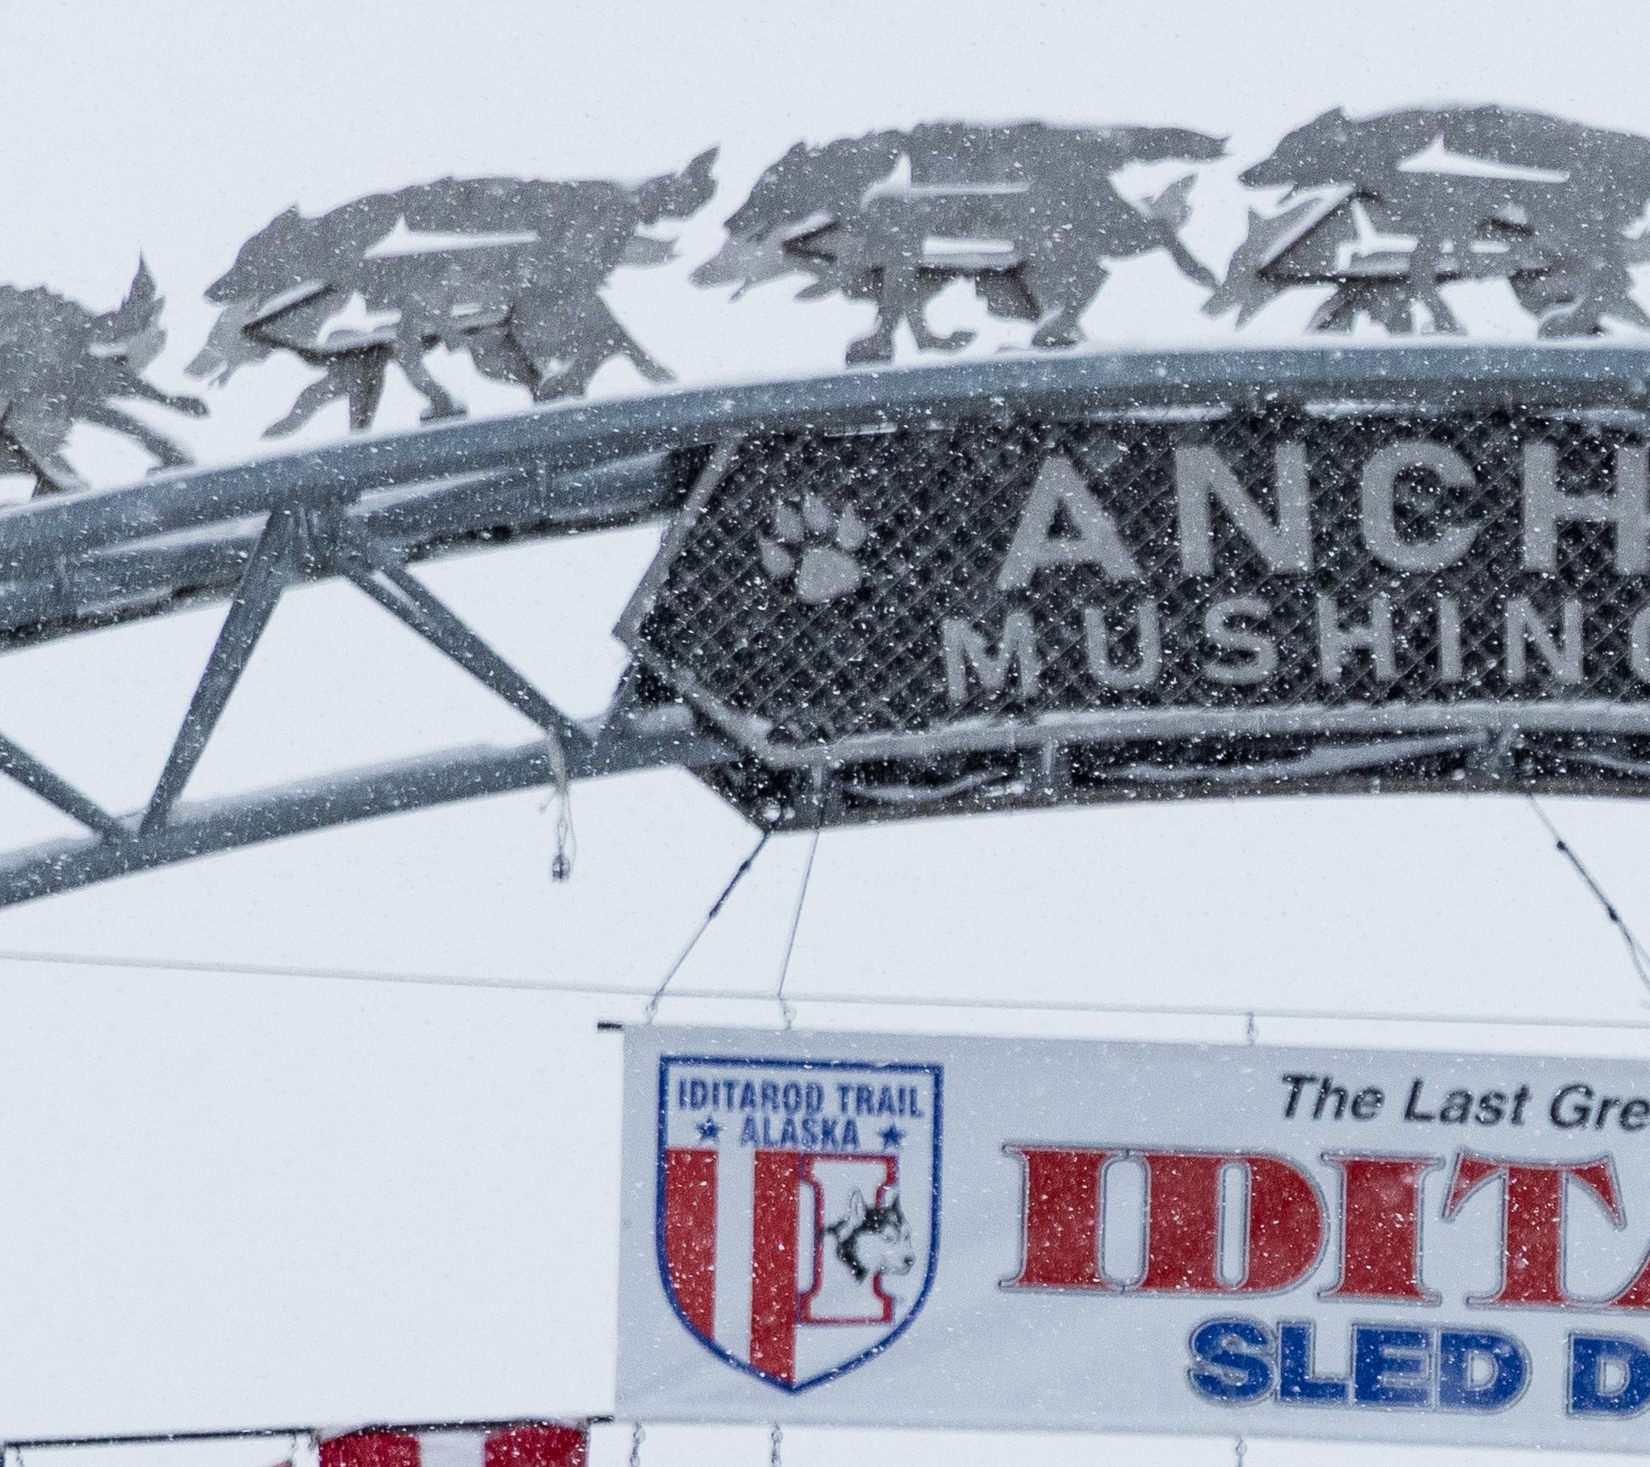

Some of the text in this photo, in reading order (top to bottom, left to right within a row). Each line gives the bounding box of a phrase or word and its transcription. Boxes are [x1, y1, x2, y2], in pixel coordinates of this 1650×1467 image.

[678, 1078, 925, 1118] IDITAROD TRAIL
[1281, 1072, 1383, 1122] The
[1402, 1078, 1530, 1128] Last
[739, 1113, 861, 1150] ALASKA
[1188, 1315, 1532, 1416] SLED
